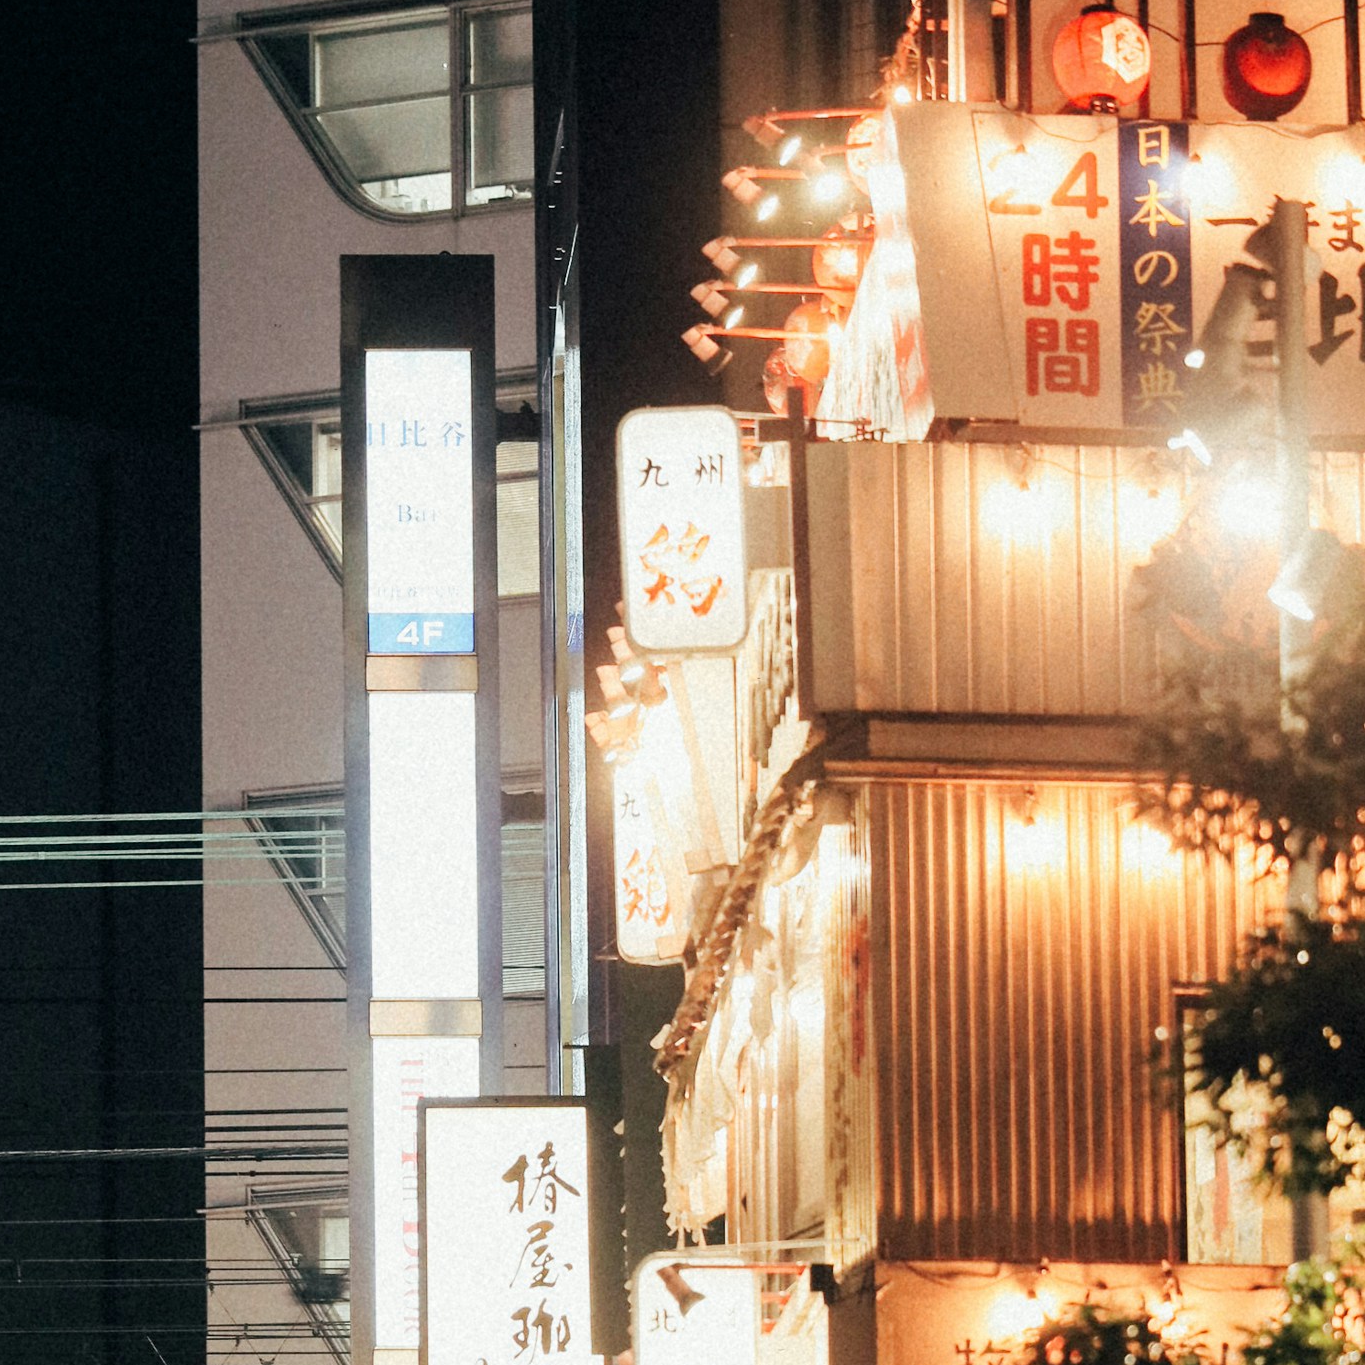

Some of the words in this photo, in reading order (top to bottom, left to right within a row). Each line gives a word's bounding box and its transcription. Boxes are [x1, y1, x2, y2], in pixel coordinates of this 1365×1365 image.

[1129, 125, 1188, 414] 日本の祭典
[638, 454, 725, 489] 九州
[396, 620, 445, 647] 4F
